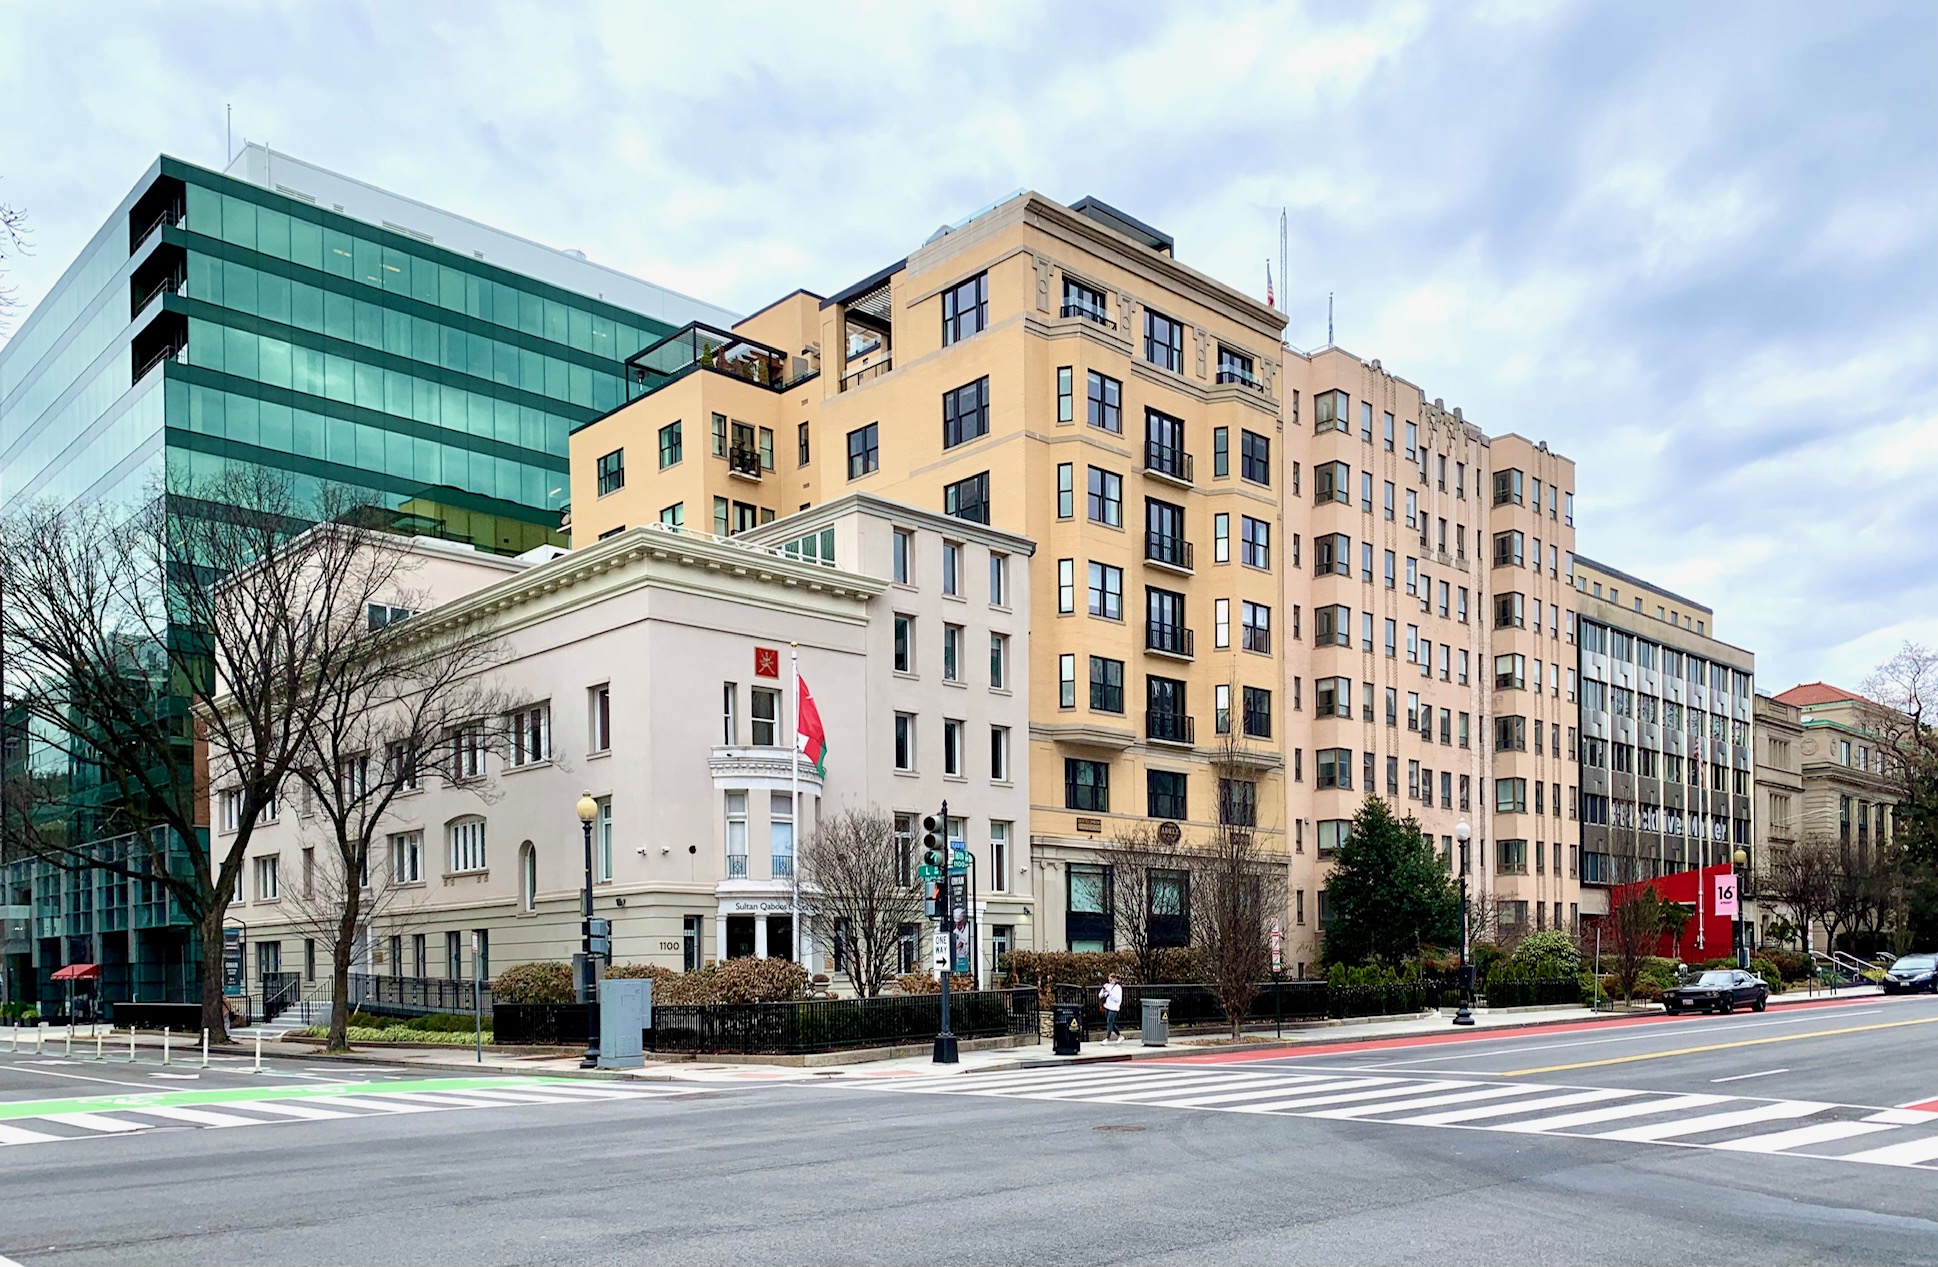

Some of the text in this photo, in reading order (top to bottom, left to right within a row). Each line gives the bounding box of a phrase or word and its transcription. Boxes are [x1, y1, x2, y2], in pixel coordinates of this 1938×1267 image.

[925, 866, 931, 875] L
[735, 902, 759, 911] Sultan
[760, 902, 788, 911] Qaboos
[935, 936, 947, 944] ONE
[659, 941, 680, 951] 1100
[935, 946, 948, 954] WAY
